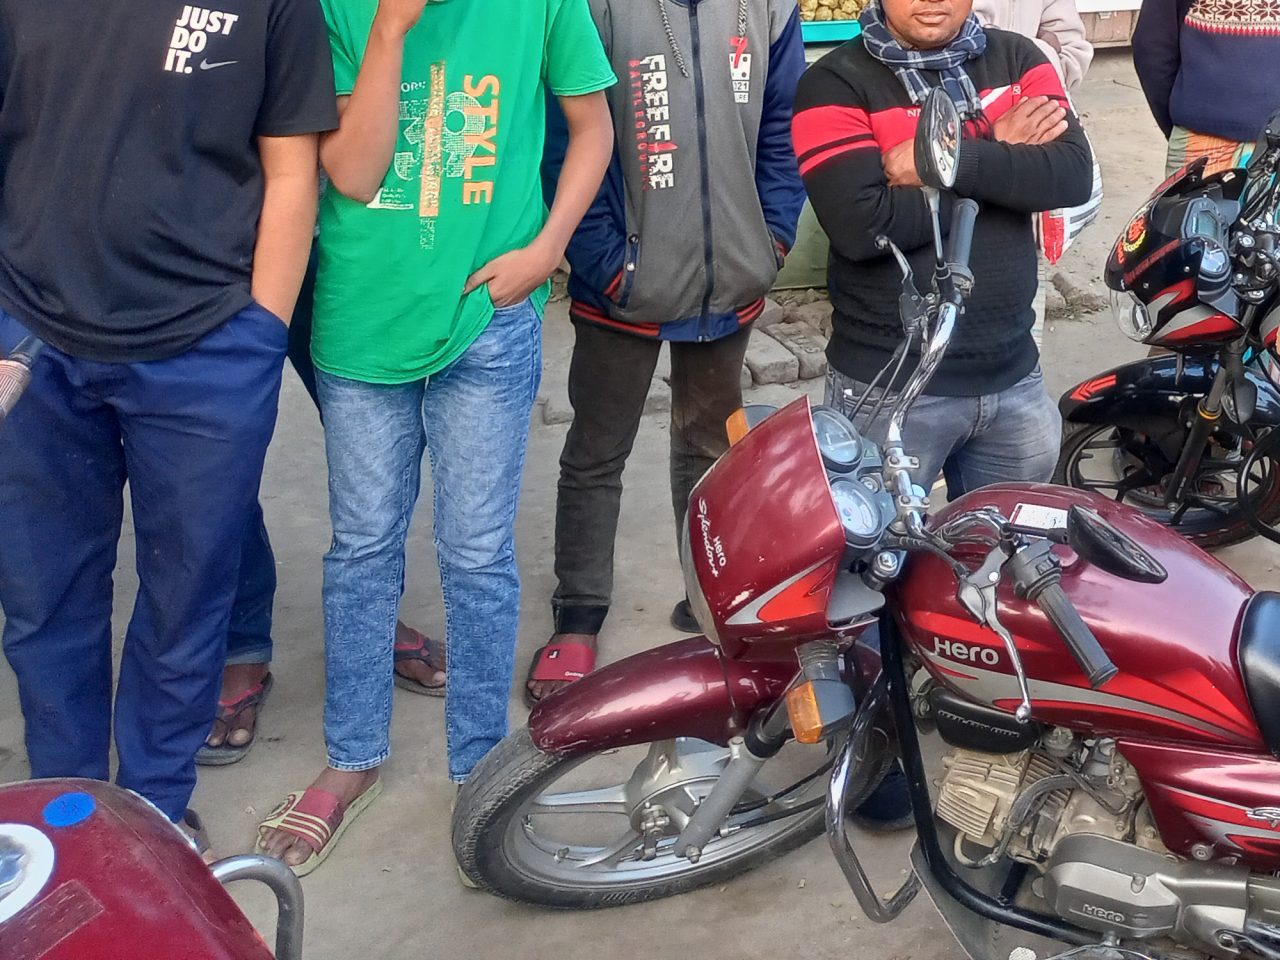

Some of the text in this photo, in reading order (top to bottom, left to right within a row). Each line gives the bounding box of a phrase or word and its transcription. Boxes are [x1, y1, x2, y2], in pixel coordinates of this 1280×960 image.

[176, 5, 239, 35] JUST
[169, 26, 208, 54] DO
[164, 48, 193, 74] IT.
[640, 53, 670, 122] FREE
[463, 74, 500, 205] STYLE
[713, 535, 727, 567] Hero
[933, 636, 1000, 666] Hero
[1083, 904, 1125, 922] Hero
